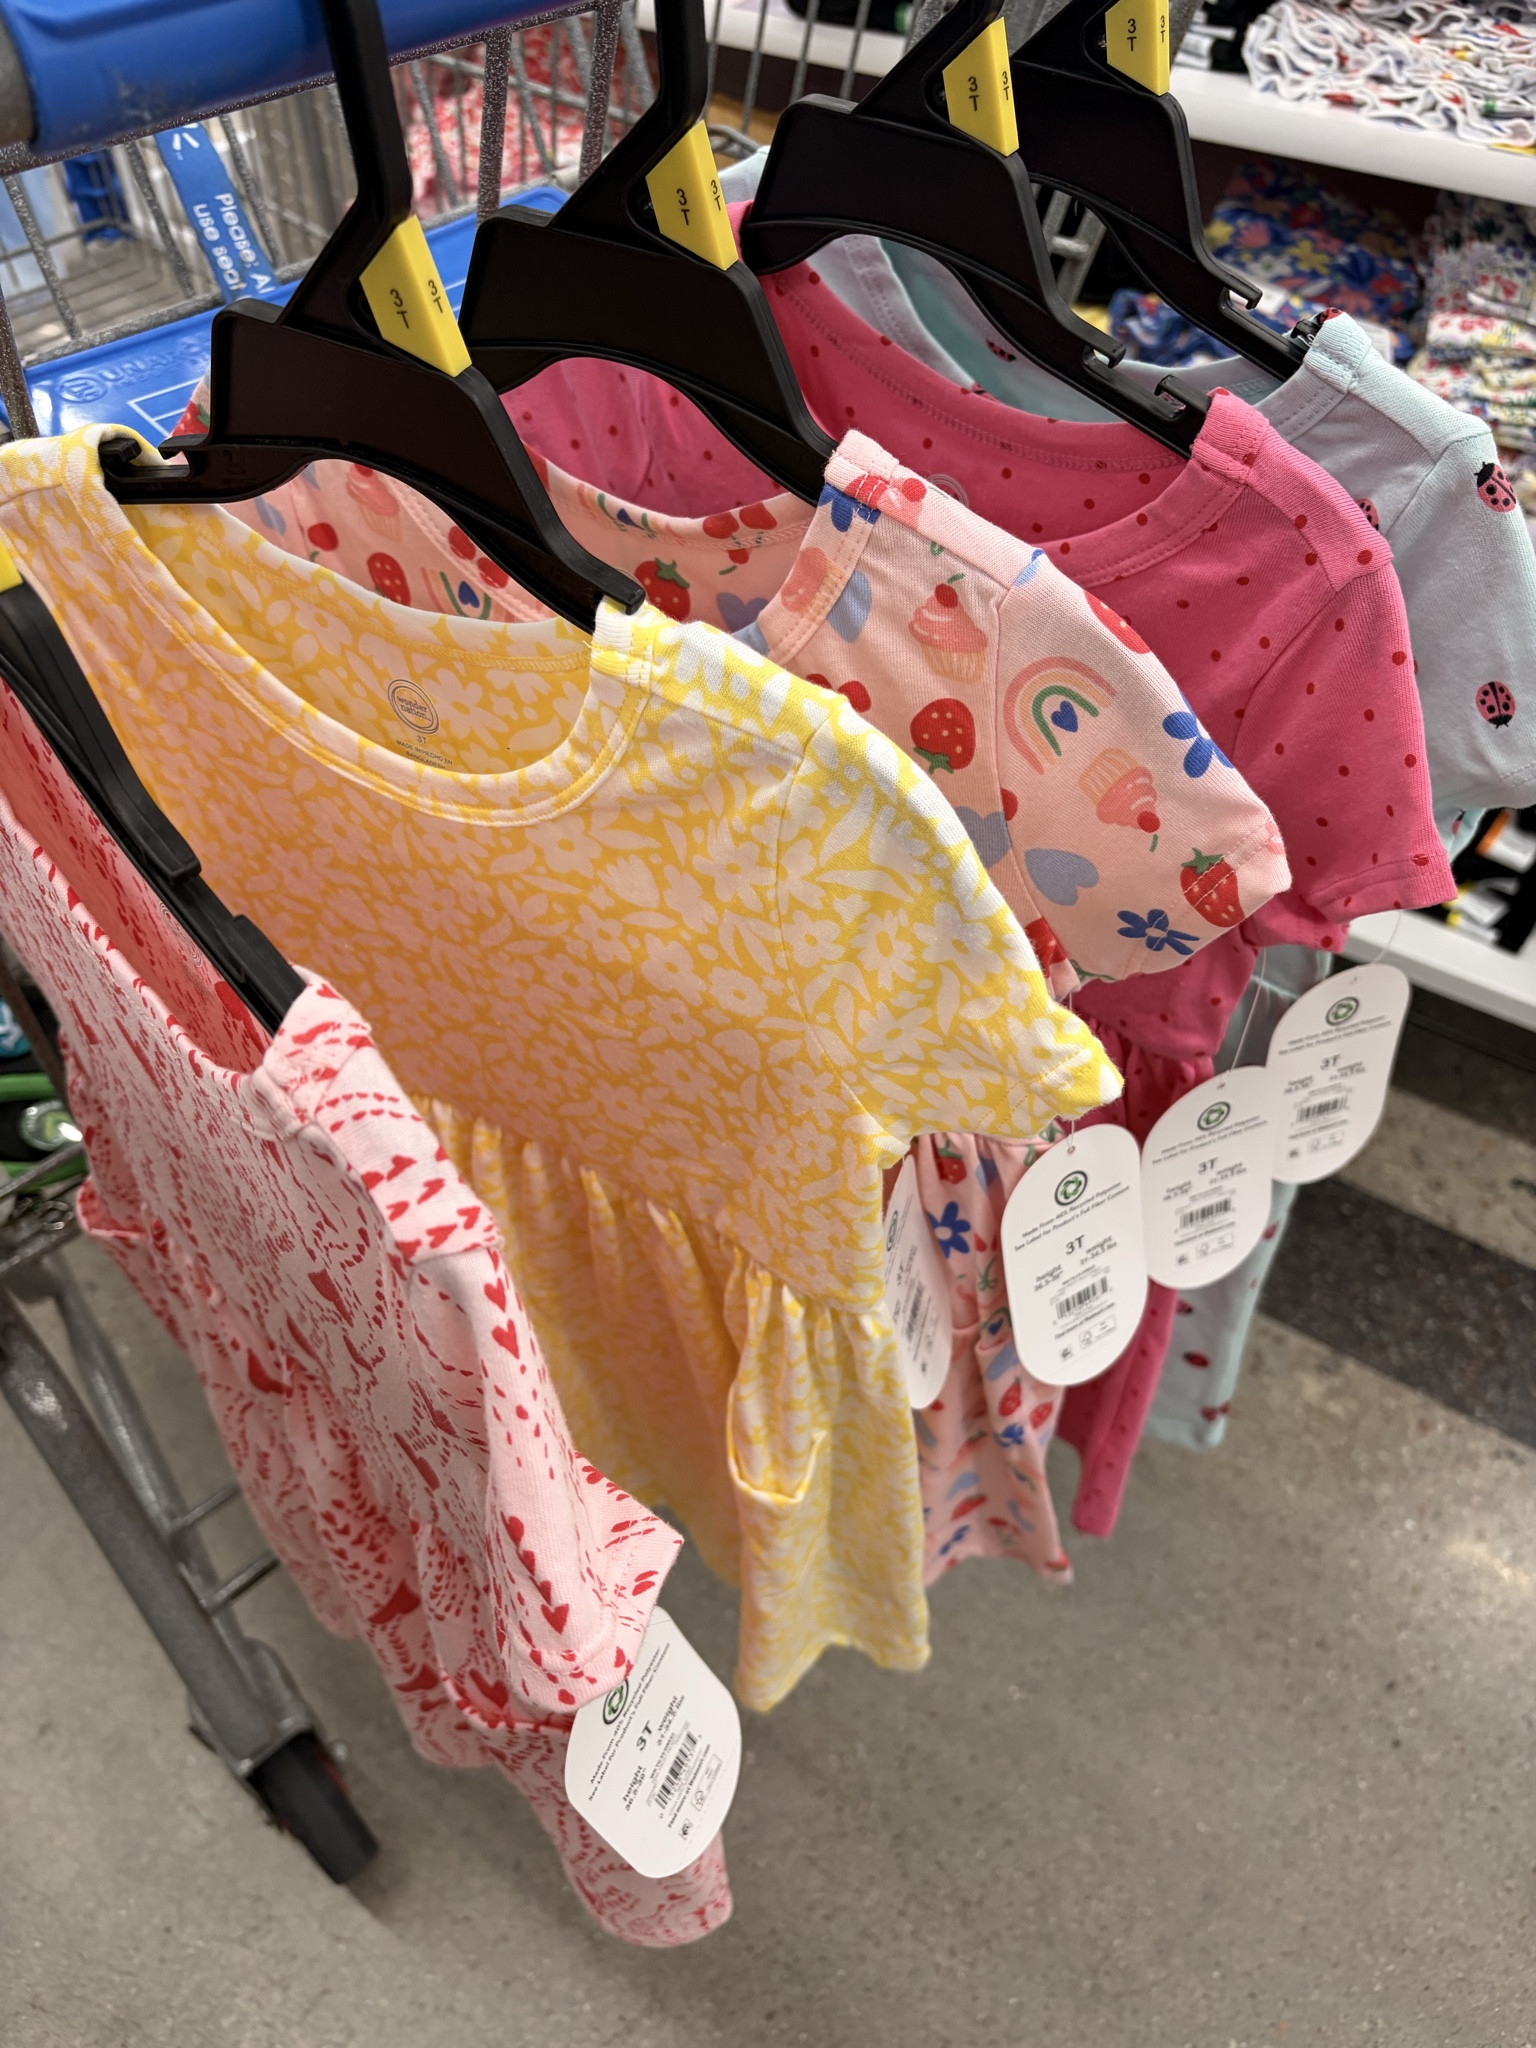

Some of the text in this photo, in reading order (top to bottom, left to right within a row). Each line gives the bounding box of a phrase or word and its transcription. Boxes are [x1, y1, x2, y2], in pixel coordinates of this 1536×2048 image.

[192, 203, 248, 290] use seat
[1197, 1156, 1218, 1174] 3T
[1064, 1234, 1085, 1255] 3T
[634, 1719, 654, 1752] 3T
